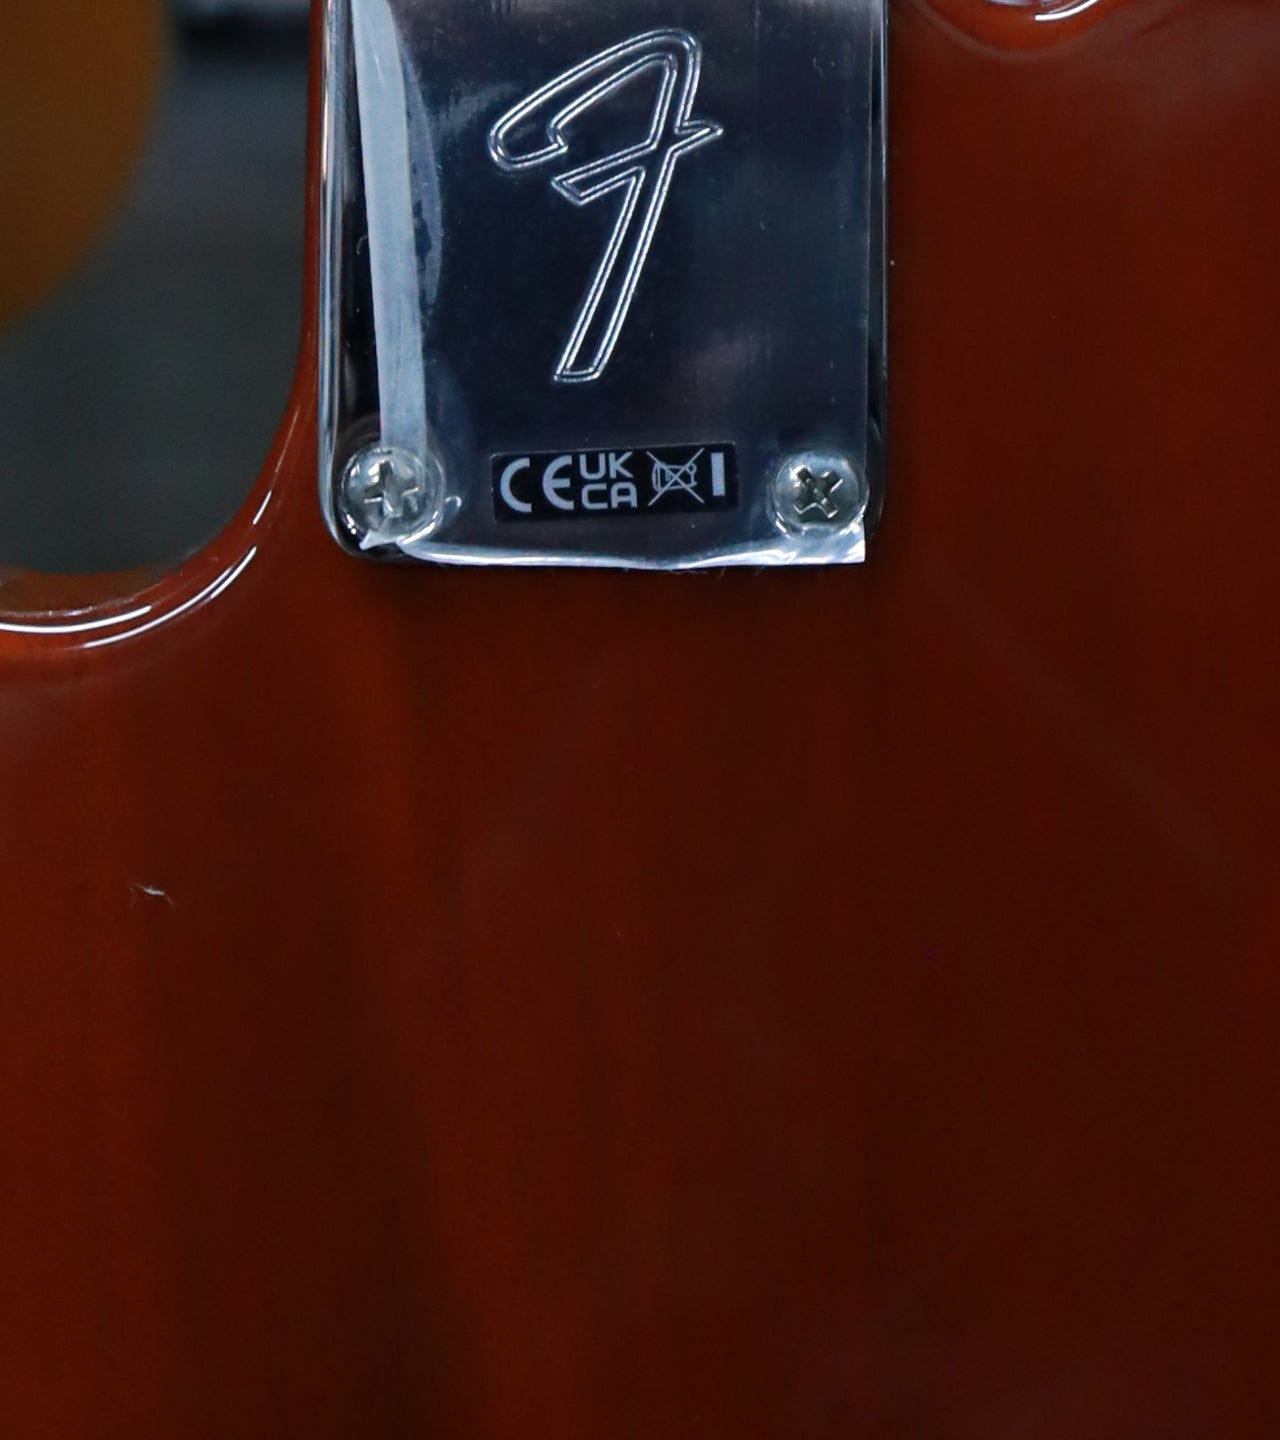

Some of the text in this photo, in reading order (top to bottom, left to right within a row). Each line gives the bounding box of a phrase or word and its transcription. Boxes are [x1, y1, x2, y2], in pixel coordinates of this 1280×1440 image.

[579, 451, 634, 480] UK
[500, 455, 574, 513] CE
[581, 481, 638, 510] CA
